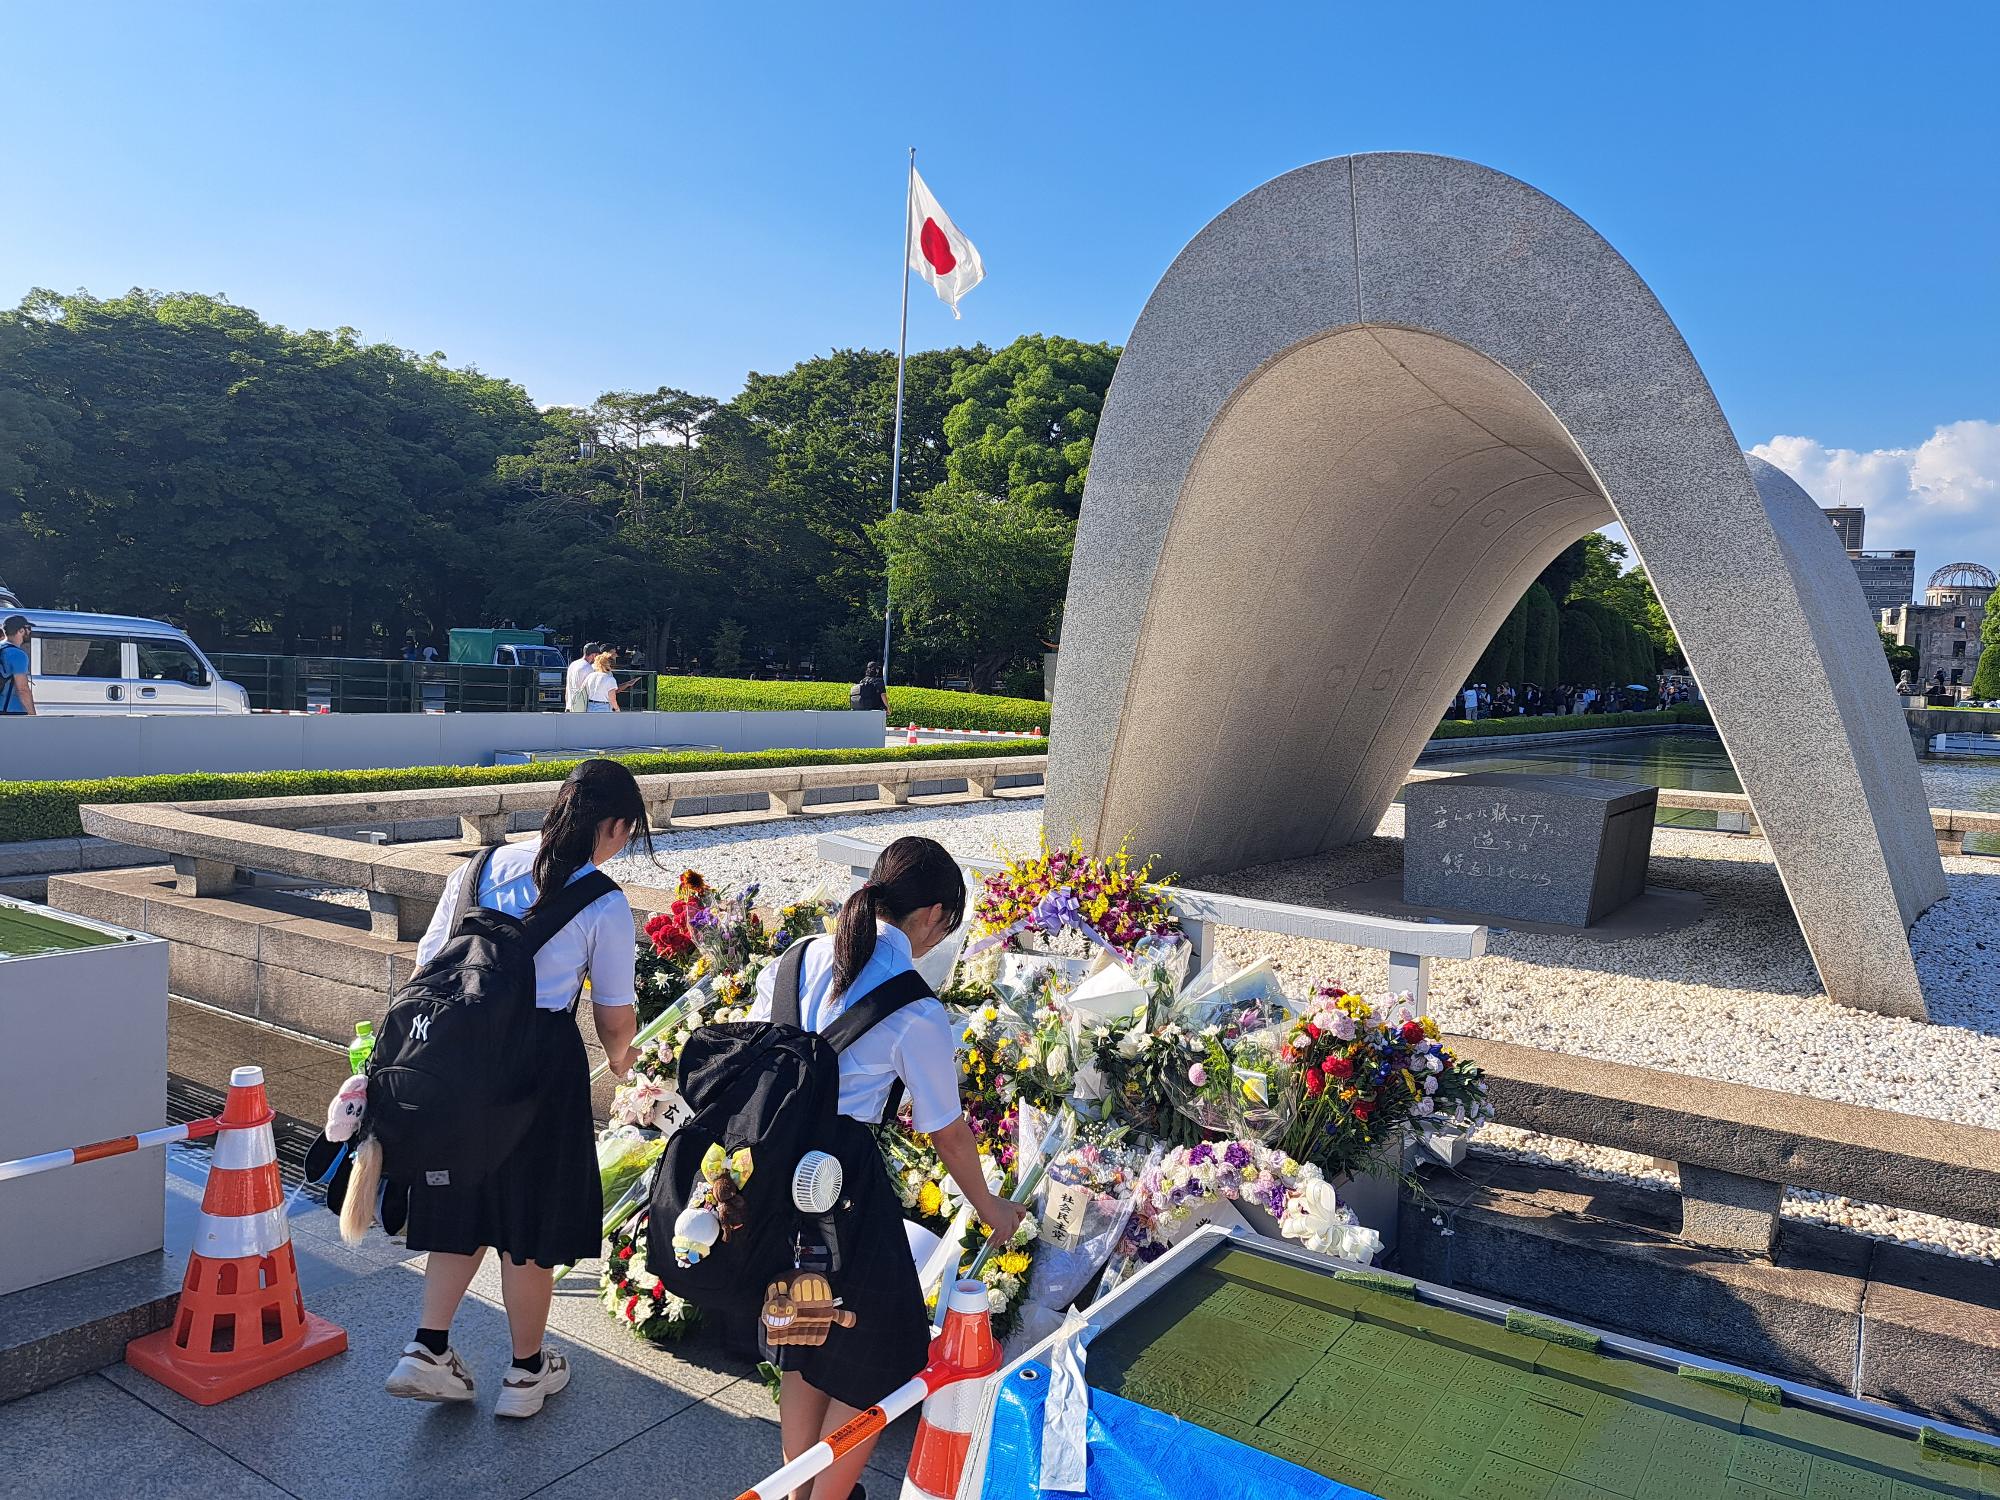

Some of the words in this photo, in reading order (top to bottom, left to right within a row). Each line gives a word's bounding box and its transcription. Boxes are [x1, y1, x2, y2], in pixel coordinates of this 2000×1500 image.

[409, 1013, 432, 1041] NY
[1051, 1193, 1074, 1241] 社会民主党
